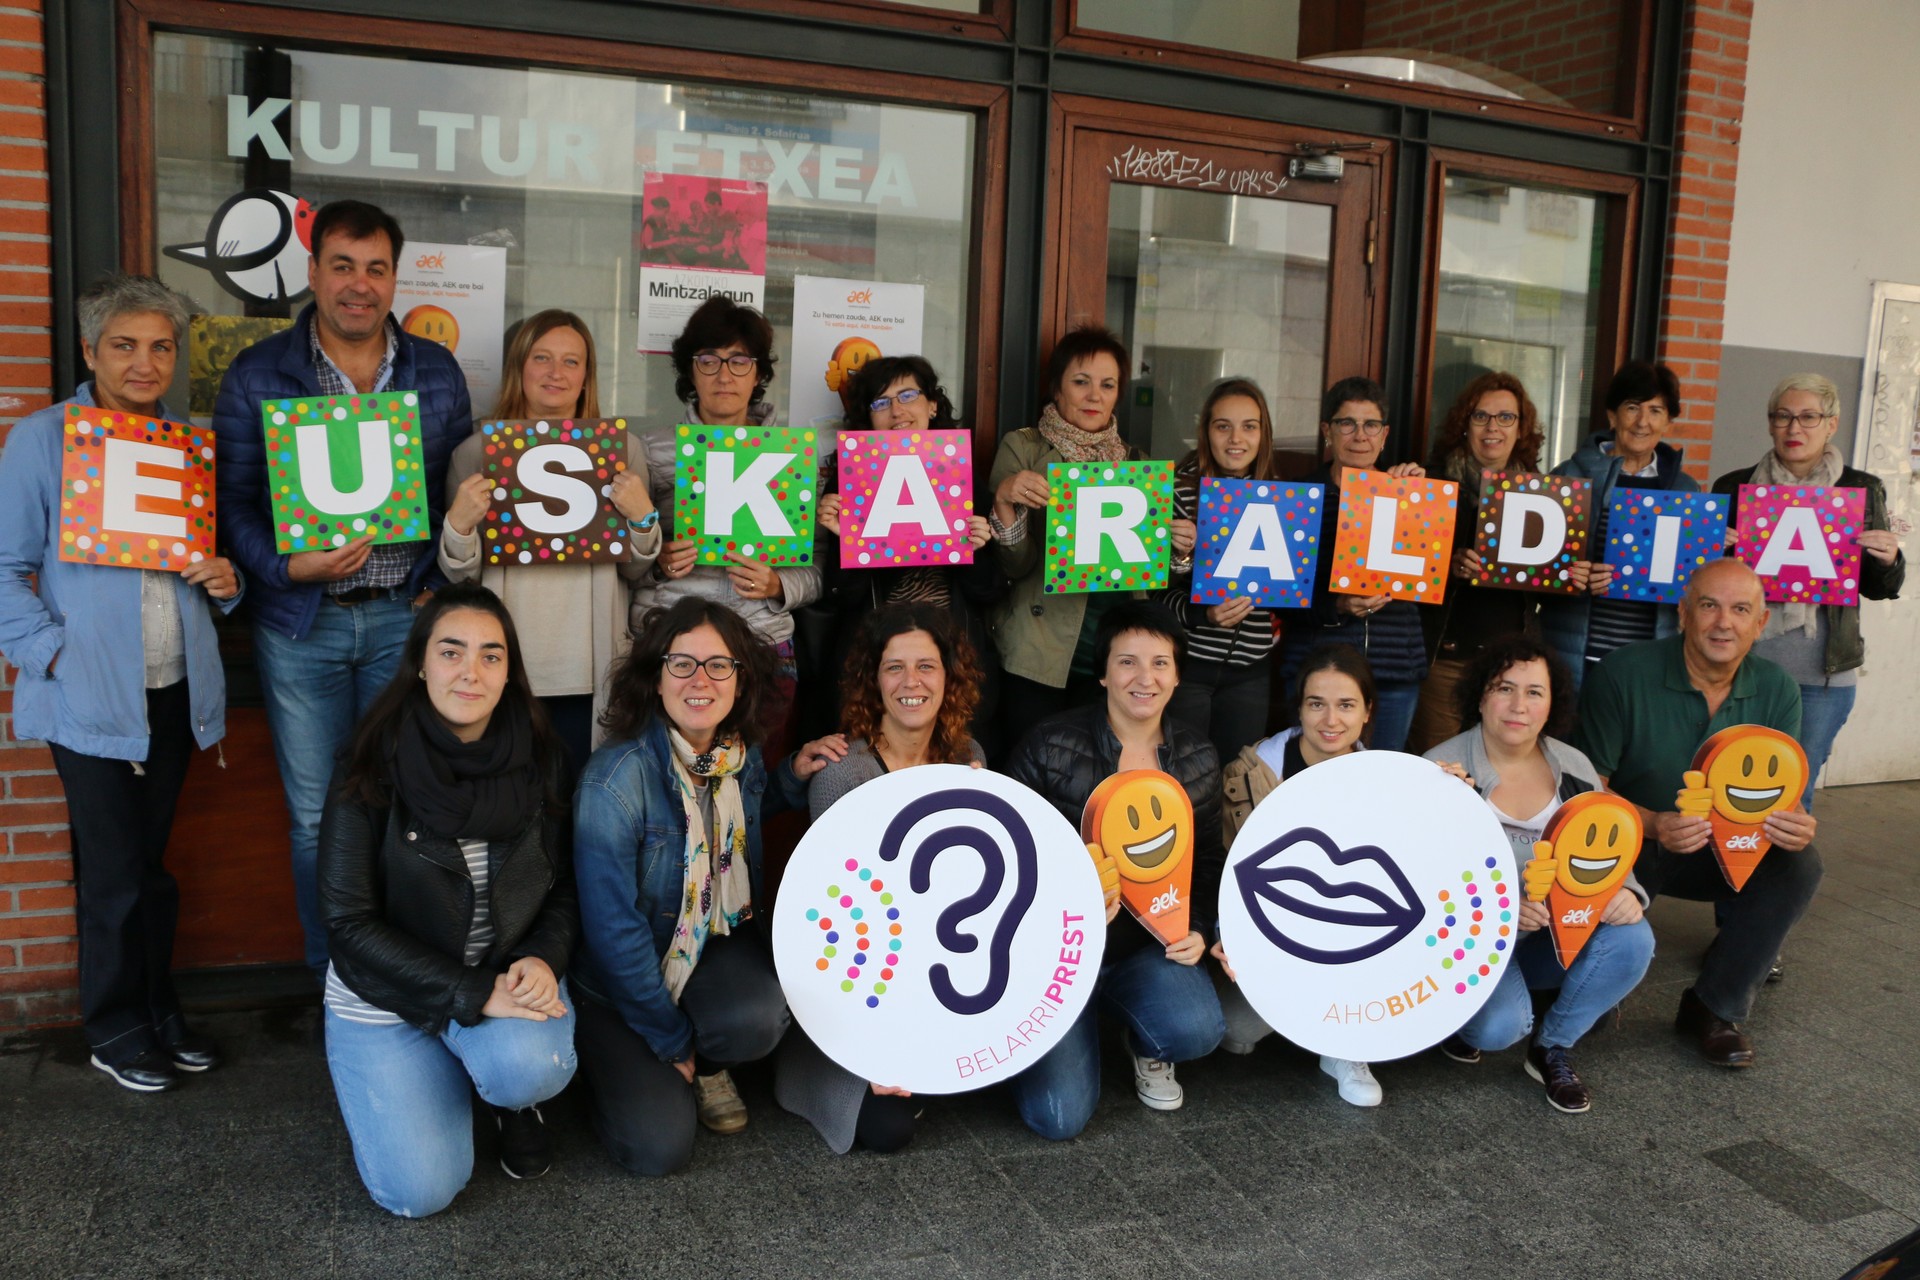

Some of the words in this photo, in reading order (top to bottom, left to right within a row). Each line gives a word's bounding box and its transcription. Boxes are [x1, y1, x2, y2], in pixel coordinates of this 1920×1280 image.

[227, 94, 599, 184] KULTUR
[655, 130, 918, 208] ETXEA
[764, 127, 811, 140] Solairua
[415, 251, 446, 269] aek
[442, 281, 457, 289] AEK
[472, 282, 484, 291] bai
[674, 273, 728, 289] AZKOITIKO
[847, 287, 873, 304] aek
[822, 311, 845, 320] hemen
[846, 313, 868, 322] zaude,
[894, 316, 905, 324] bai
[103, 438, 187, 538] E
[295, 420, 394, 515] U
[514, 443, 598, 534] S
[704, 452, 796, 536] K
[863, 455, 951, 538] A
[1074, 486, 1150, 565] R
[1213, 503, 1295, 580] A
[1366, 497, 1425, 576] L
[1497, 491, 1567, 566] D
[1648, 514, 1682, 584] I
[1754, 506, 1838, 580] A
[1725, 831, 1761, 849] aek
[1149, 883, 1181, 914] aek
[1562, 904, 1600, 924] aek
[956, 910, 1084, 1078] BELARRIPREST
[1323, 975, 1439, 1024] AHOBIZI
